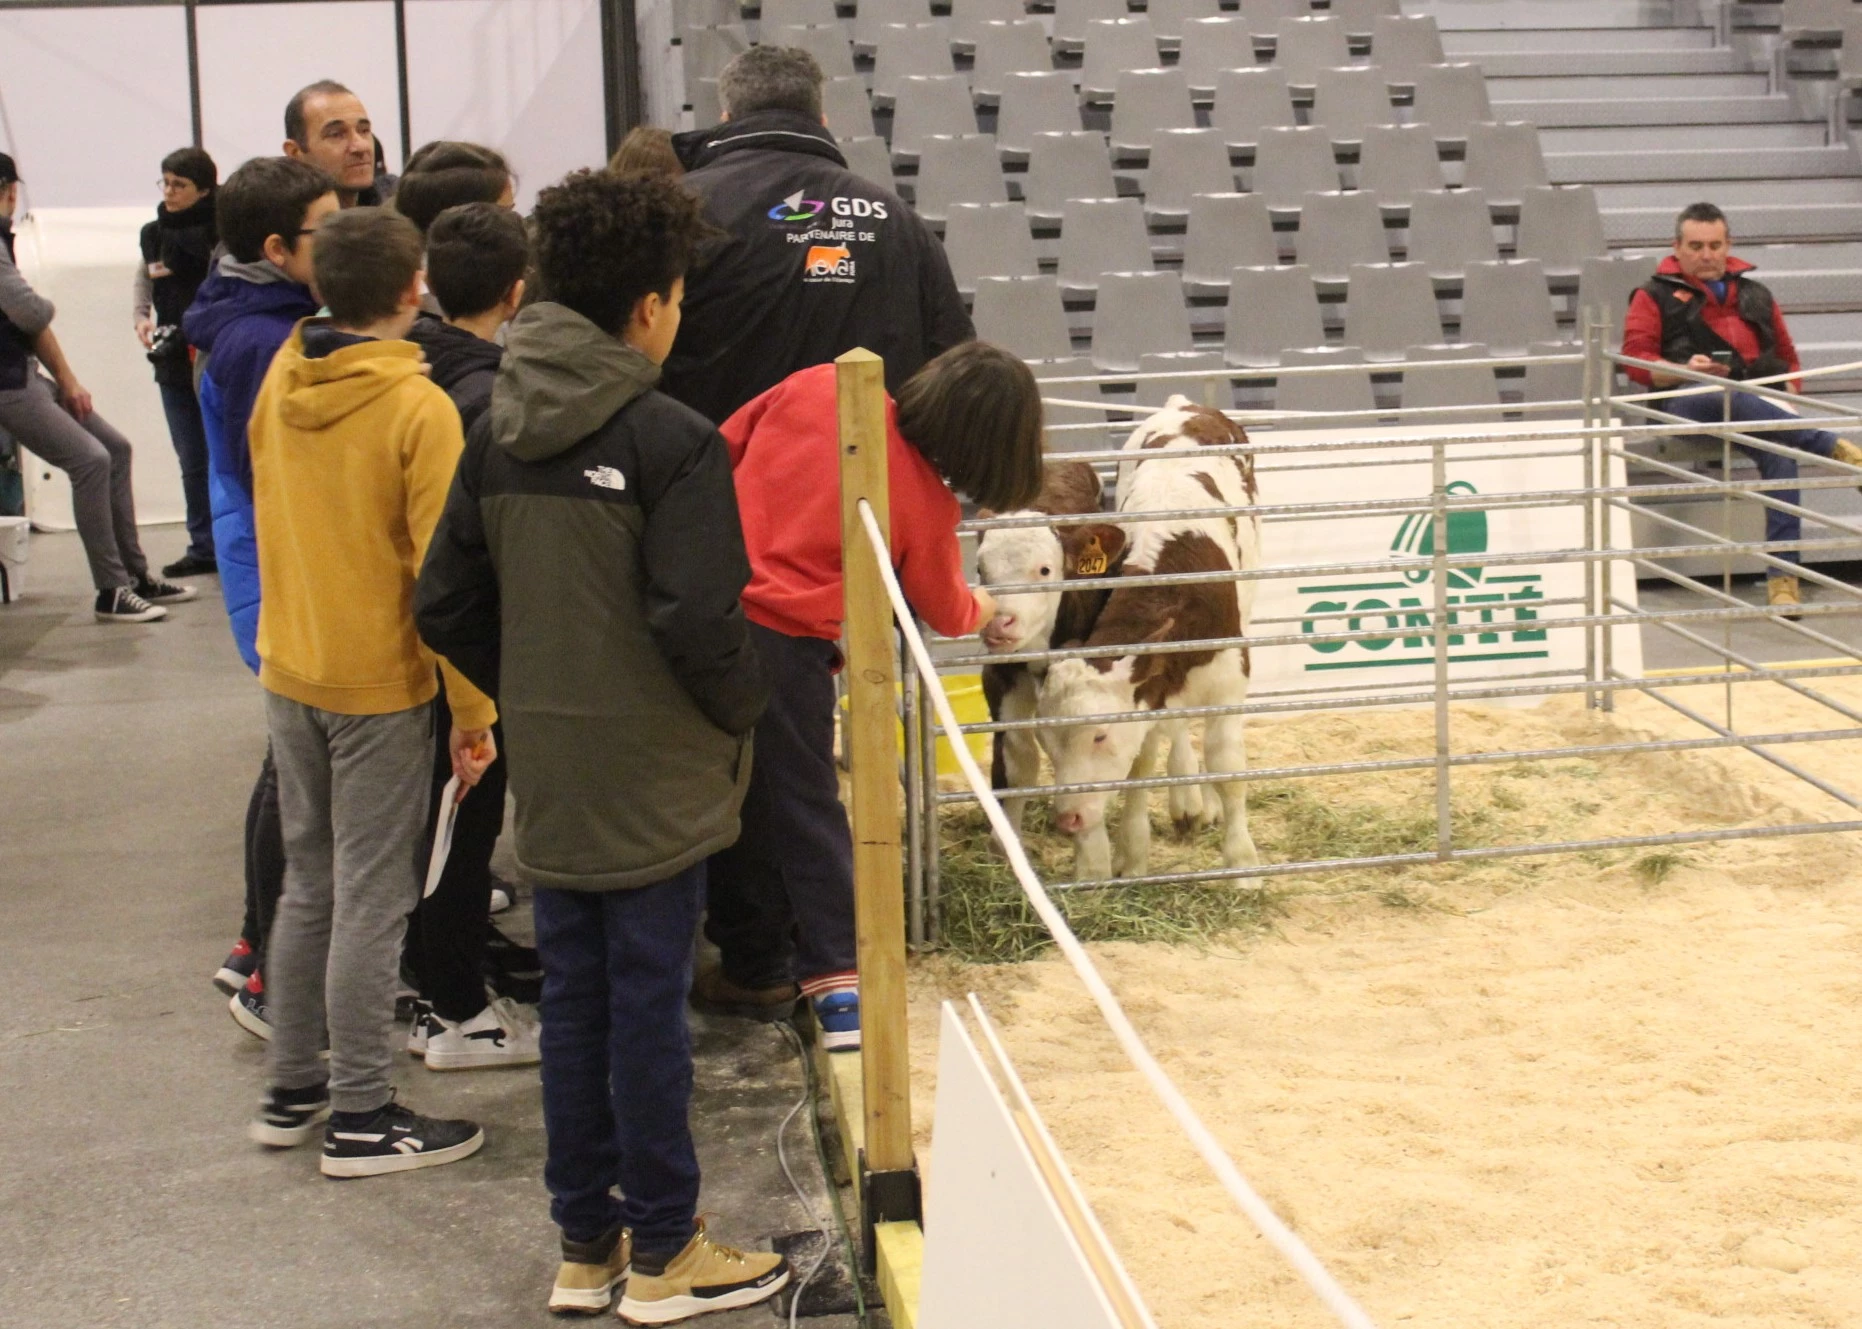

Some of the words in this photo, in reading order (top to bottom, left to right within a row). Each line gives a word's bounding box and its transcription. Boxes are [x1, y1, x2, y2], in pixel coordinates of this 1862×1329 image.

[831, 196, 888, 220] GDS
[786, 229, 856, 243] PARTENAIRE
[858, 231, 876, 242] DE
[1079, 557, 1104, 573] 2047
